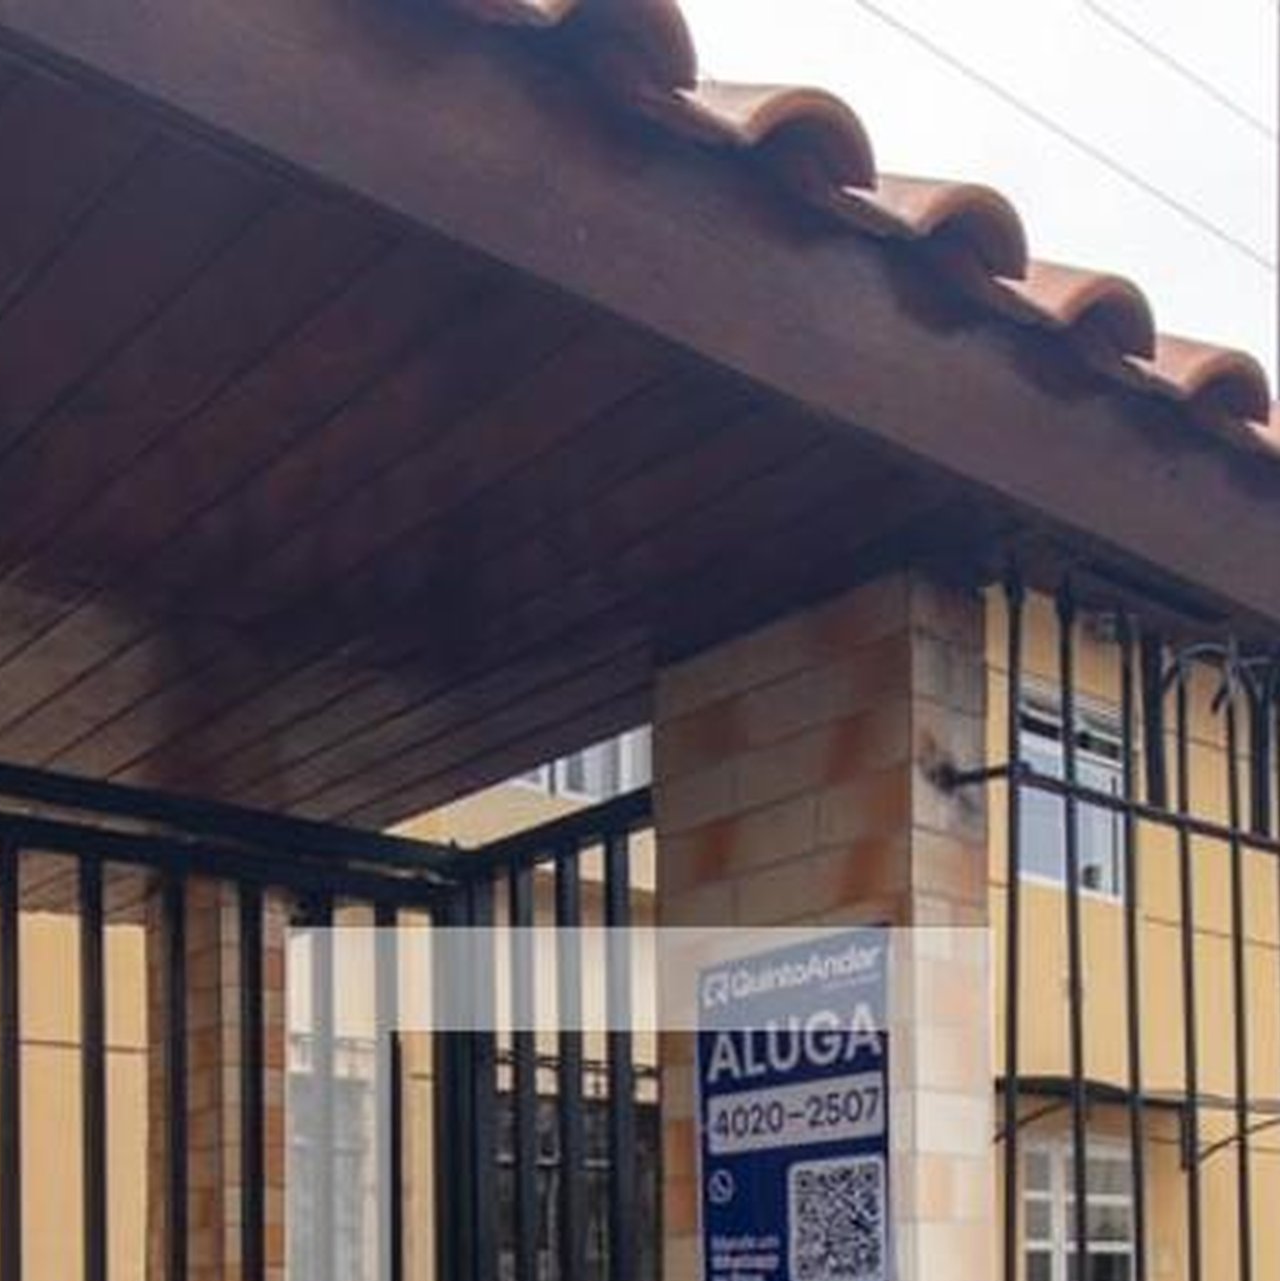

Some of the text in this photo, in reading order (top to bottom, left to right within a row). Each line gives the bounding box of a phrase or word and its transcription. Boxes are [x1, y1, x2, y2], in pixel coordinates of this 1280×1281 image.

[731, 946, 880, 998] QuintoAndar
[708, 1003, 881, 1083] ALUGA
[714, 1087, 879, 1138] 4020-2507
